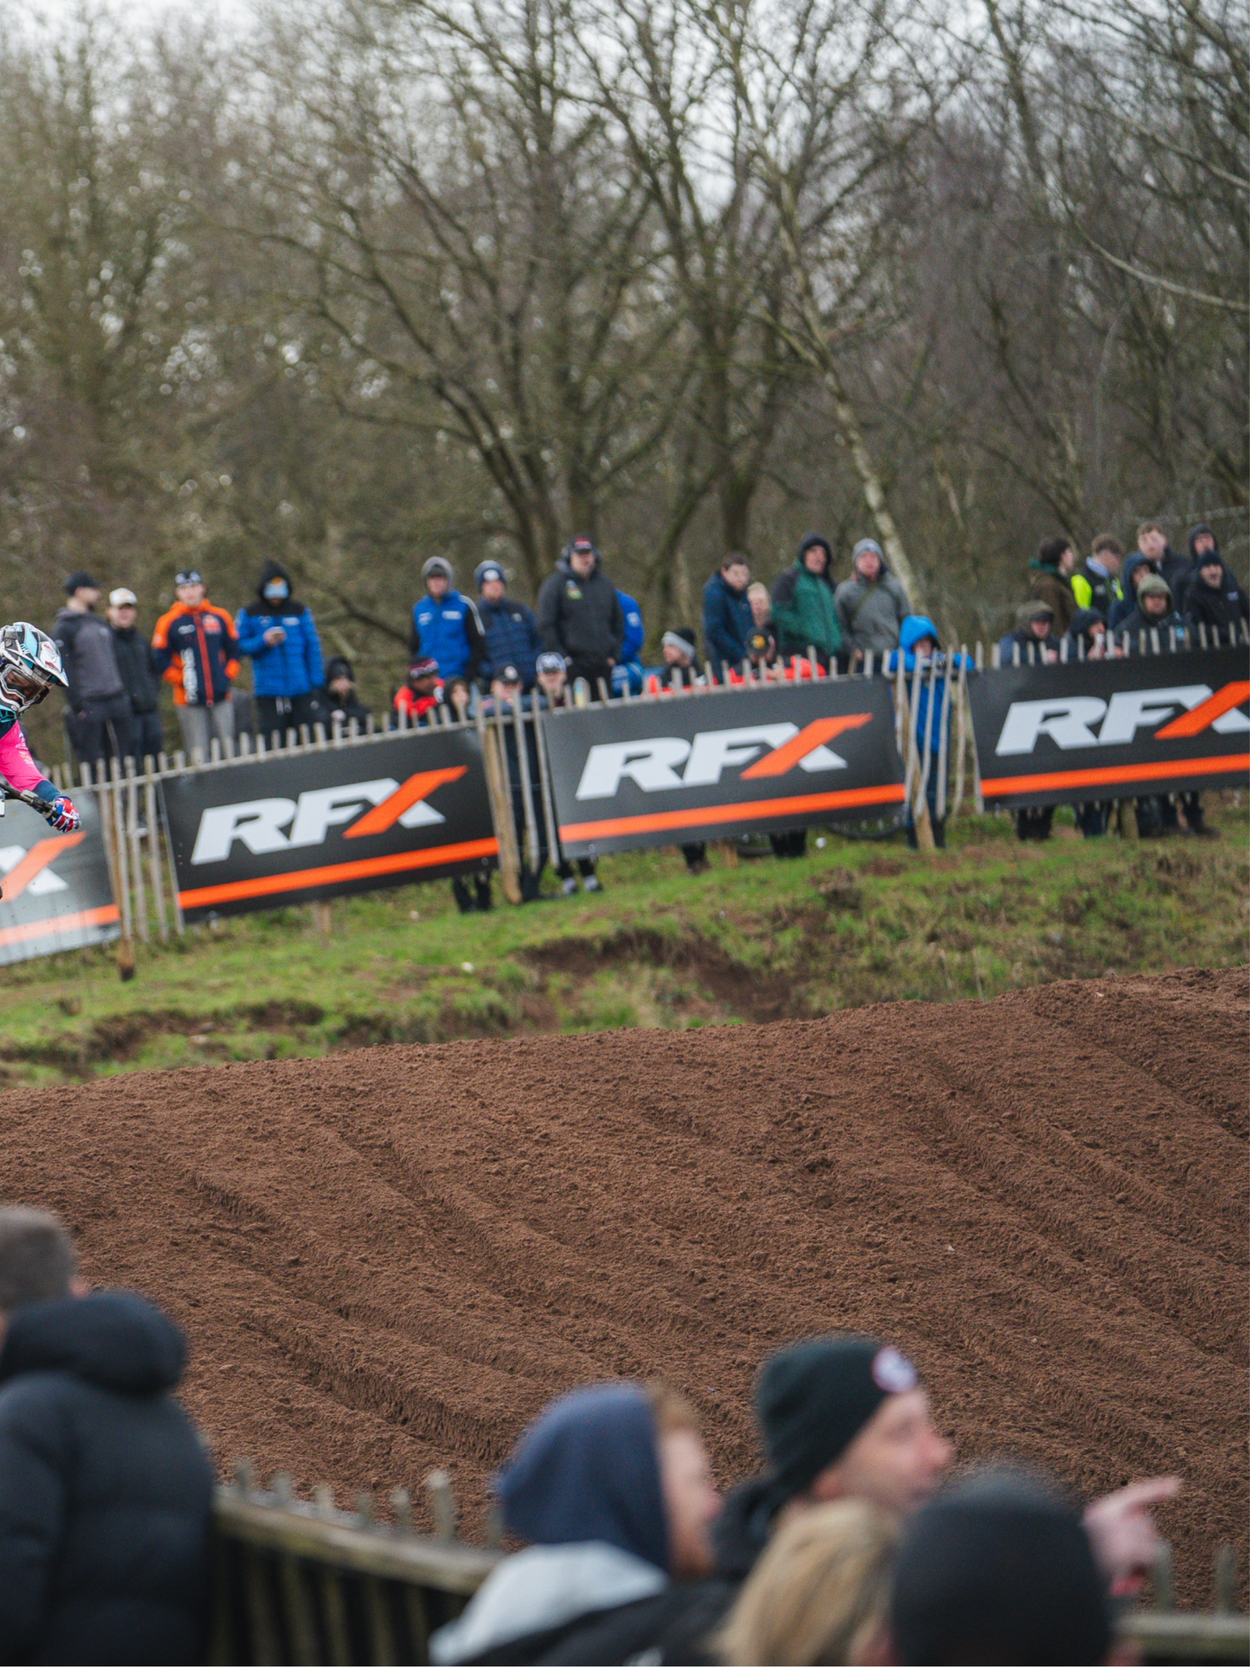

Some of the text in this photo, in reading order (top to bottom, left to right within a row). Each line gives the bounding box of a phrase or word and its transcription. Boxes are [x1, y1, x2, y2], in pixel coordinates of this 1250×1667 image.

[575, 712, 873, 800] RFX
[995, 680, 1250, 757] RFX
[191, 765, 468, 866] RFX
